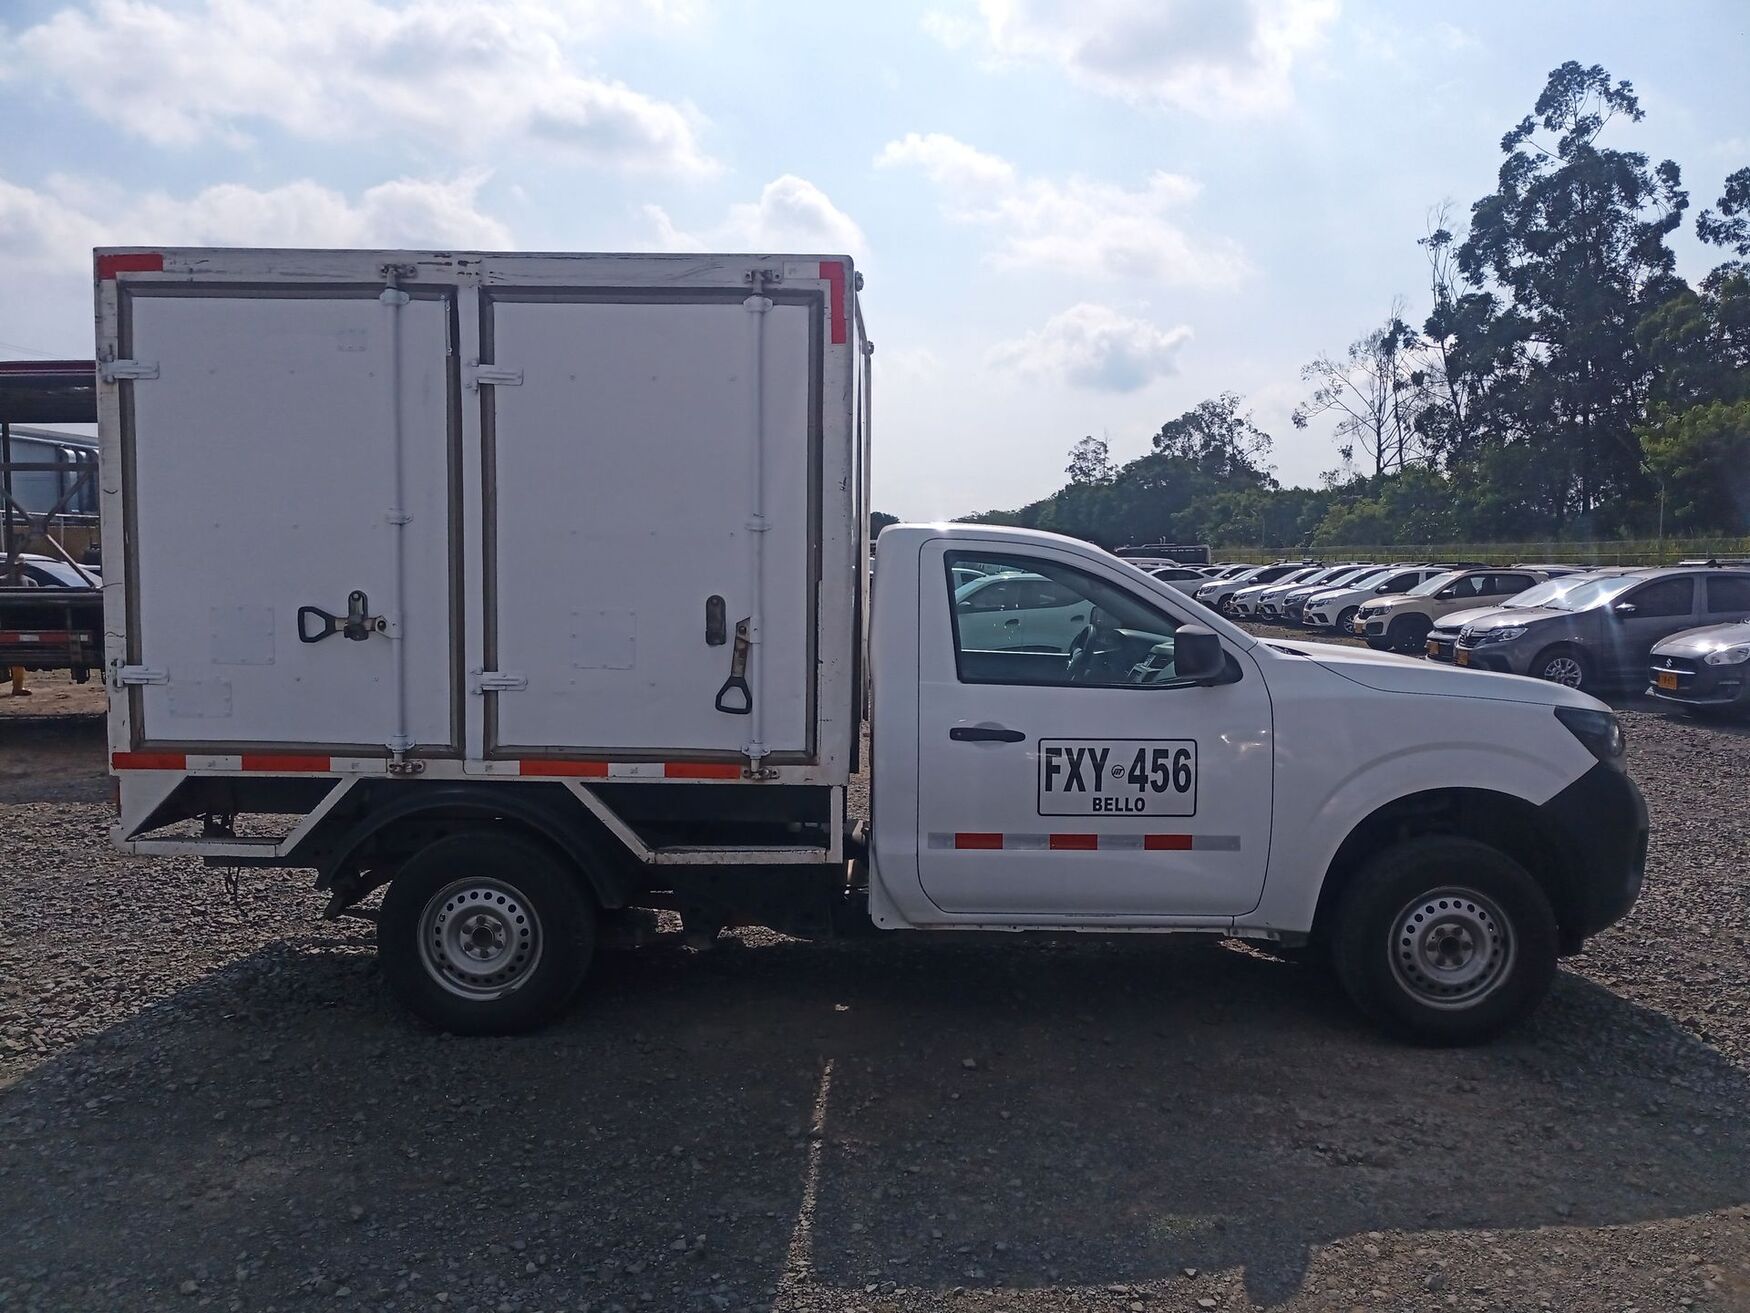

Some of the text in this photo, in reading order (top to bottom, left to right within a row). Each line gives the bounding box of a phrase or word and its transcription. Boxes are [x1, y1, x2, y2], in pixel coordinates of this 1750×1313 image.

[1045, 747, 1192, 793] FXY 456
[1092, 797, 1146, 812] BELLO
